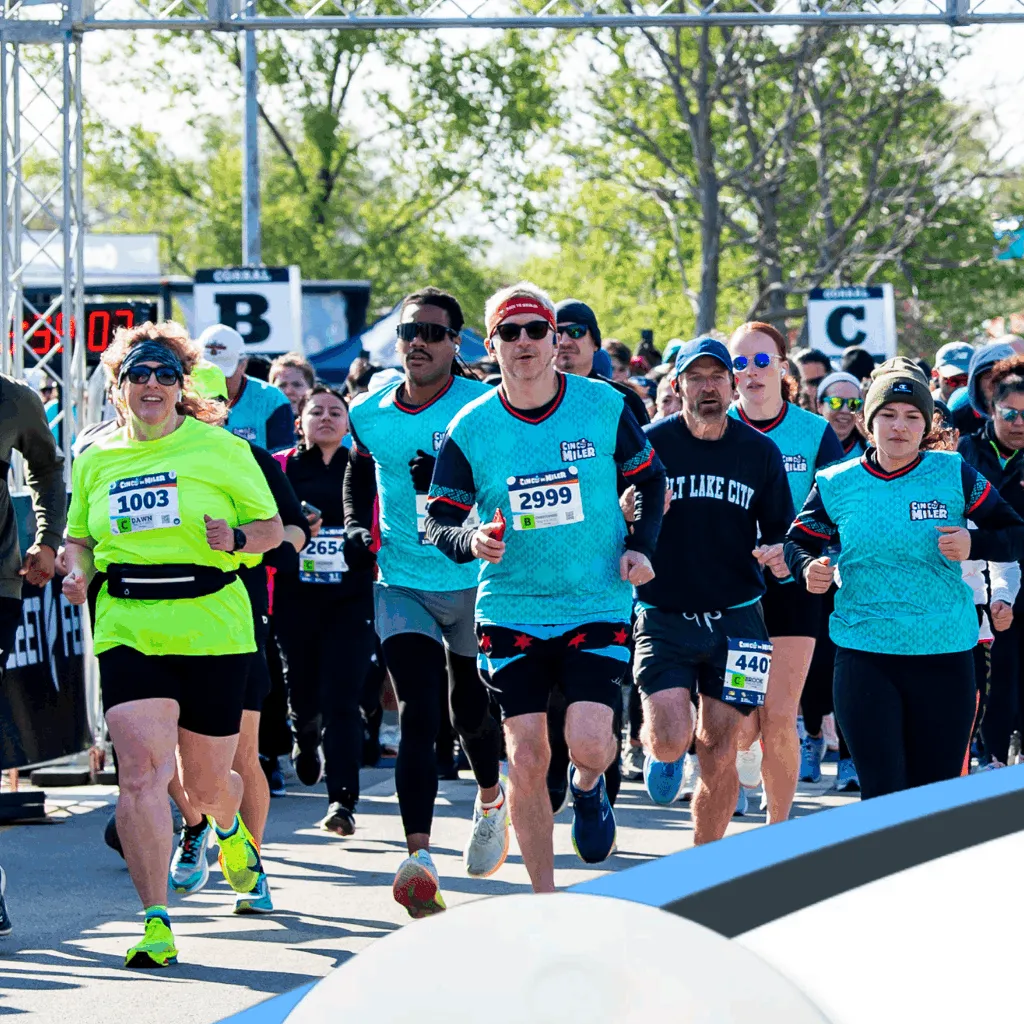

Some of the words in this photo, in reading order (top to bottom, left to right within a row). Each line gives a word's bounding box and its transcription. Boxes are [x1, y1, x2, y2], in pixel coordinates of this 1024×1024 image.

[214, 294, 270, 345] B
[826, 305, 867, 348] C
[561, 446, 596, 462] MILER
[117, 489, 170, 514] 1003
[518, 486, 572, 511] 2999
[667, 475, 686, 500] LT
[689, 474, 725, 500] LAKE
[727, 479, 755, 510] CITY
[131, 515, 153, 524] DAWN
[523, 517, 532, 527] B
[911, 509, 948, 520] MILER
[306, 540, 345, 555] 2654
[735, 654, 771, 674] 440
